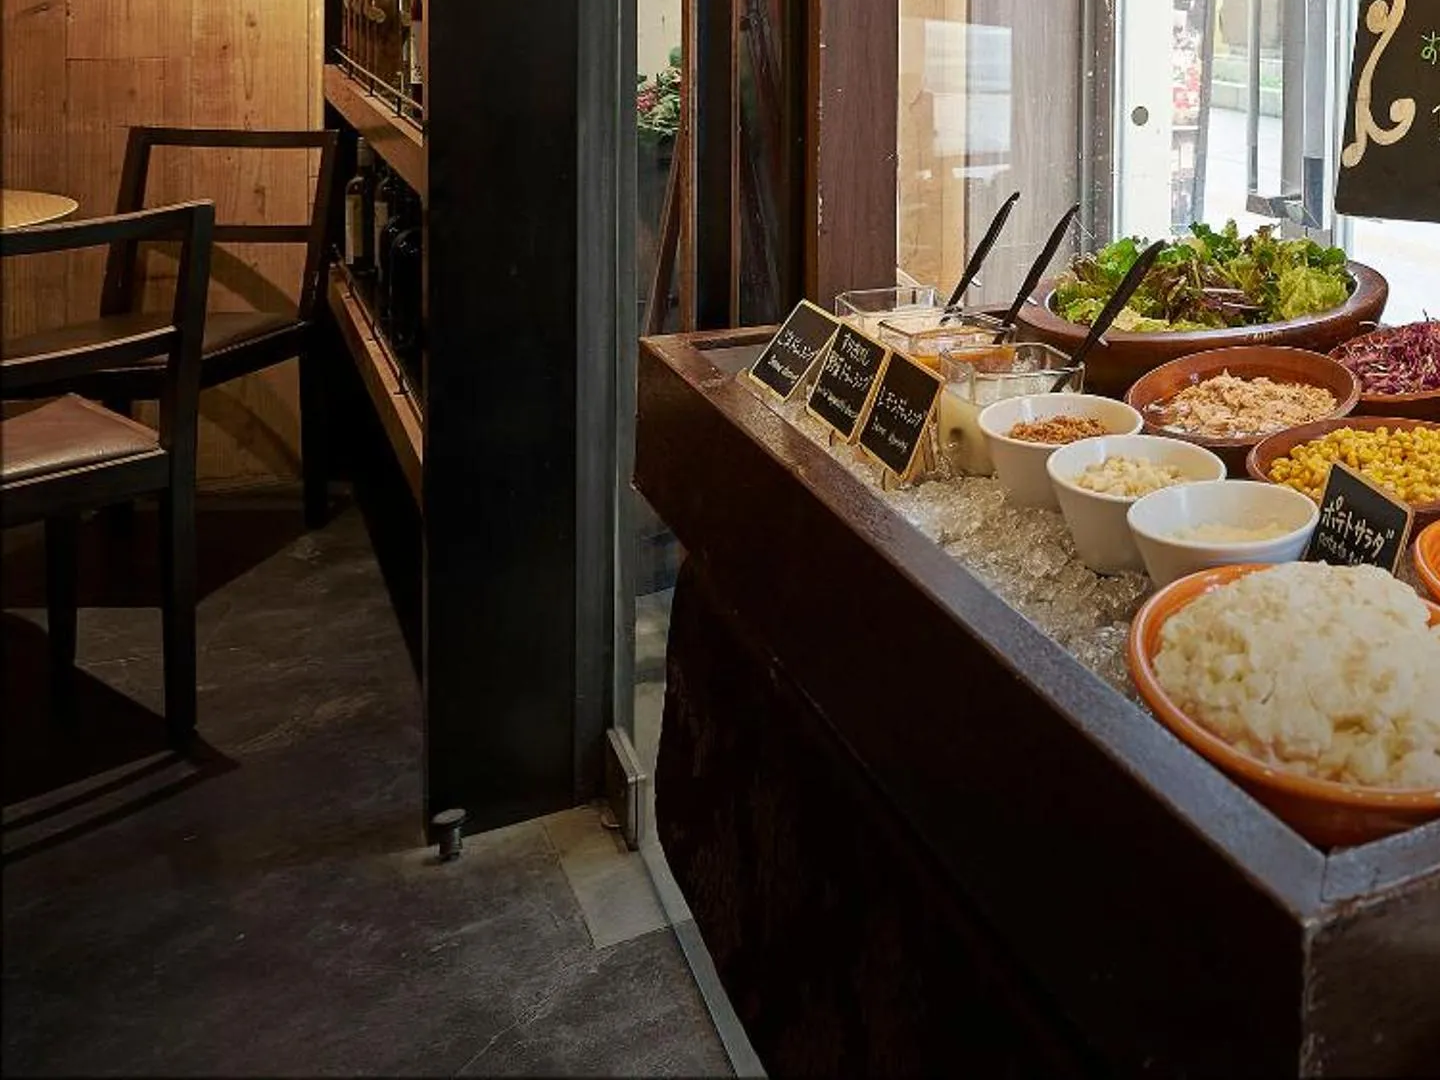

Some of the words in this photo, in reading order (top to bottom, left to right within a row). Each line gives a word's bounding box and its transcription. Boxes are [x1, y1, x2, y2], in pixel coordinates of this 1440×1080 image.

[1321, 495, 1396, 558] ポテトサラダ
